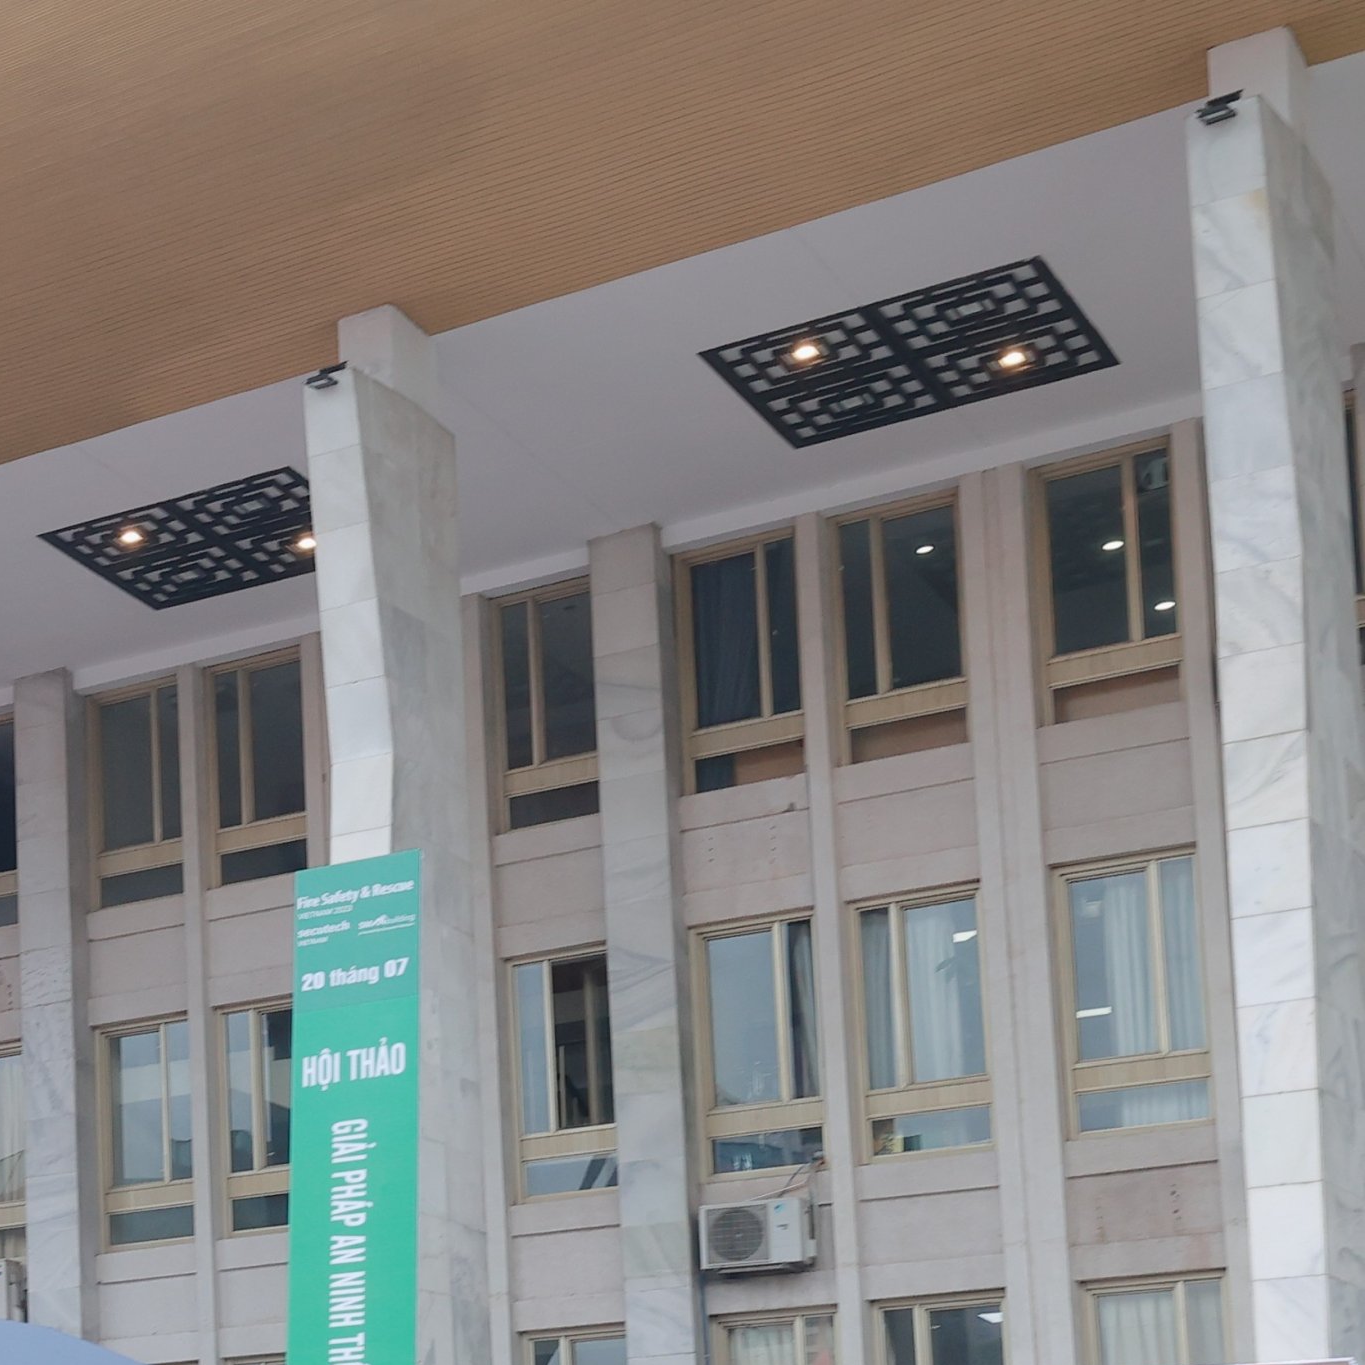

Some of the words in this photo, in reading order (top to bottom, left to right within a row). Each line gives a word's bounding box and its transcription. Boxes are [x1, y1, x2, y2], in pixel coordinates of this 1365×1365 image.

[296, 895, 320, 910] Fire
[321, 889, 360, 905] Safety
[360, 885, 371, 899] &
[372, 880, 415, 896] Rescue
[301, 971, 325, 992] 20
[329, 964, 380, 988] tháng
[384, 957, 410, 978] 07
[301, 1048, 341, 1091] HỘI
[346, 1037, 406, 1082] THẢO
[330, 1117, 376, 1164] GIẢI
[329, 1168, 374, 1228] PHÁP
[329, 1235, 366, 1266] AN
[328, 1270, 366, 1329] NINH
